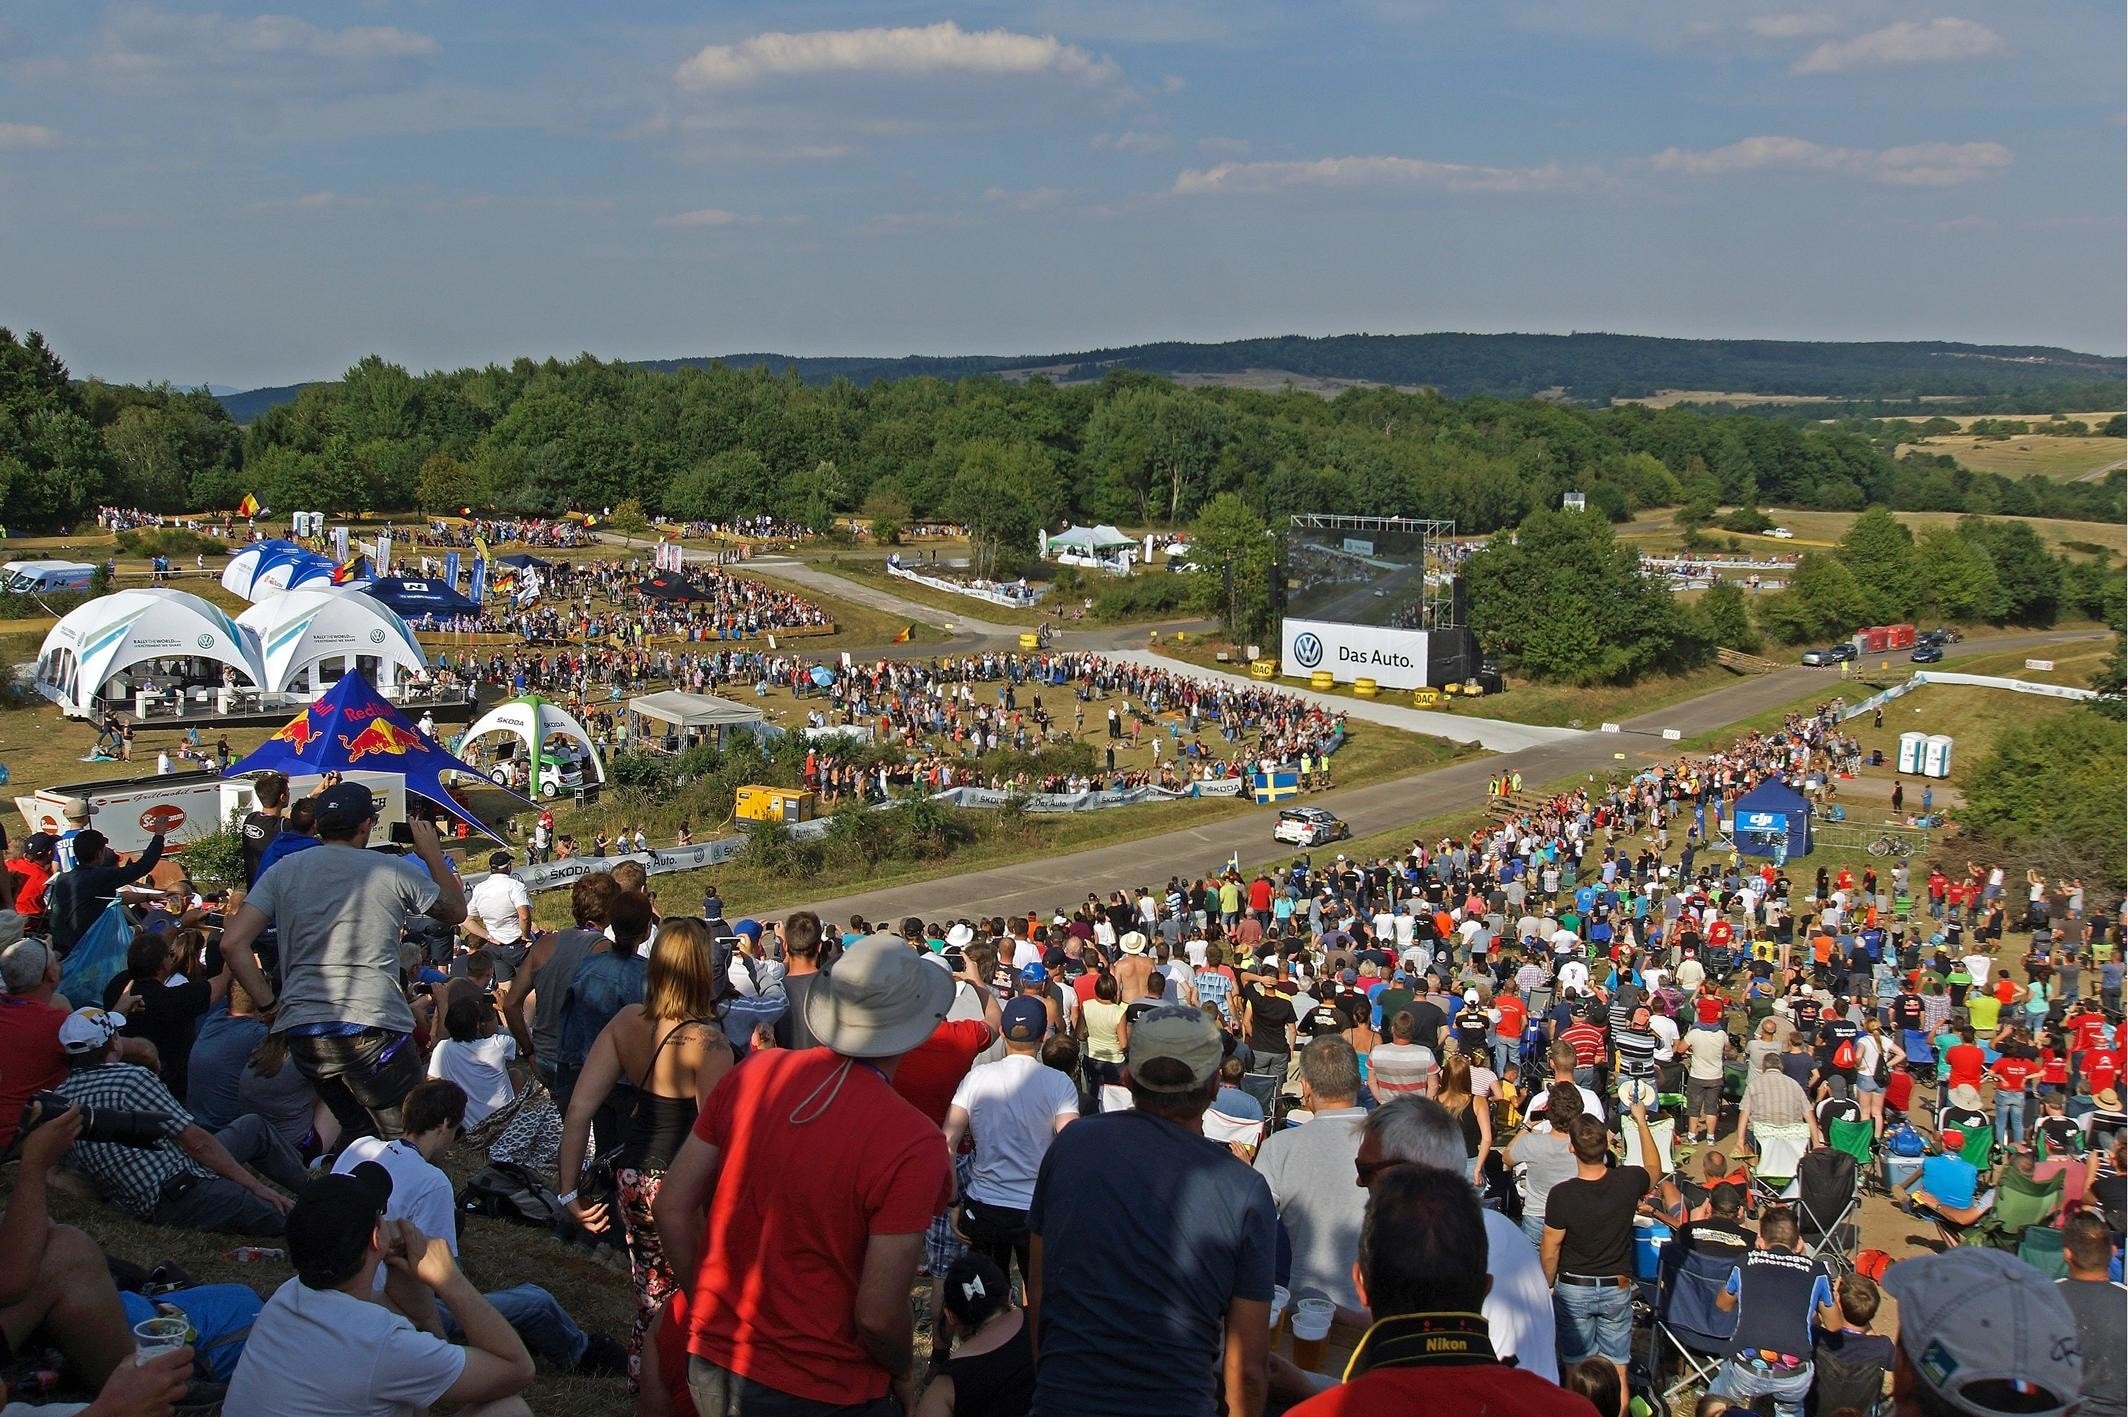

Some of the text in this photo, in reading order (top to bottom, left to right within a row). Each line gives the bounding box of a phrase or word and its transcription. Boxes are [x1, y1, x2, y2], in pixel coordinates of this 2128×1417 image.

[1339, 646, 1414, 669] Das Auto.
[344, 702, 376, 722] Red
[653, 856, 678, 868] Auto.
[550, 864, 591, 880] ŠKODA
[1747, 1249, 1813, 1267] Volkswagen
[1747, 1256, 1811, 1272] Motorsport
[1426, 1338, 1468, 1351] Nikon
